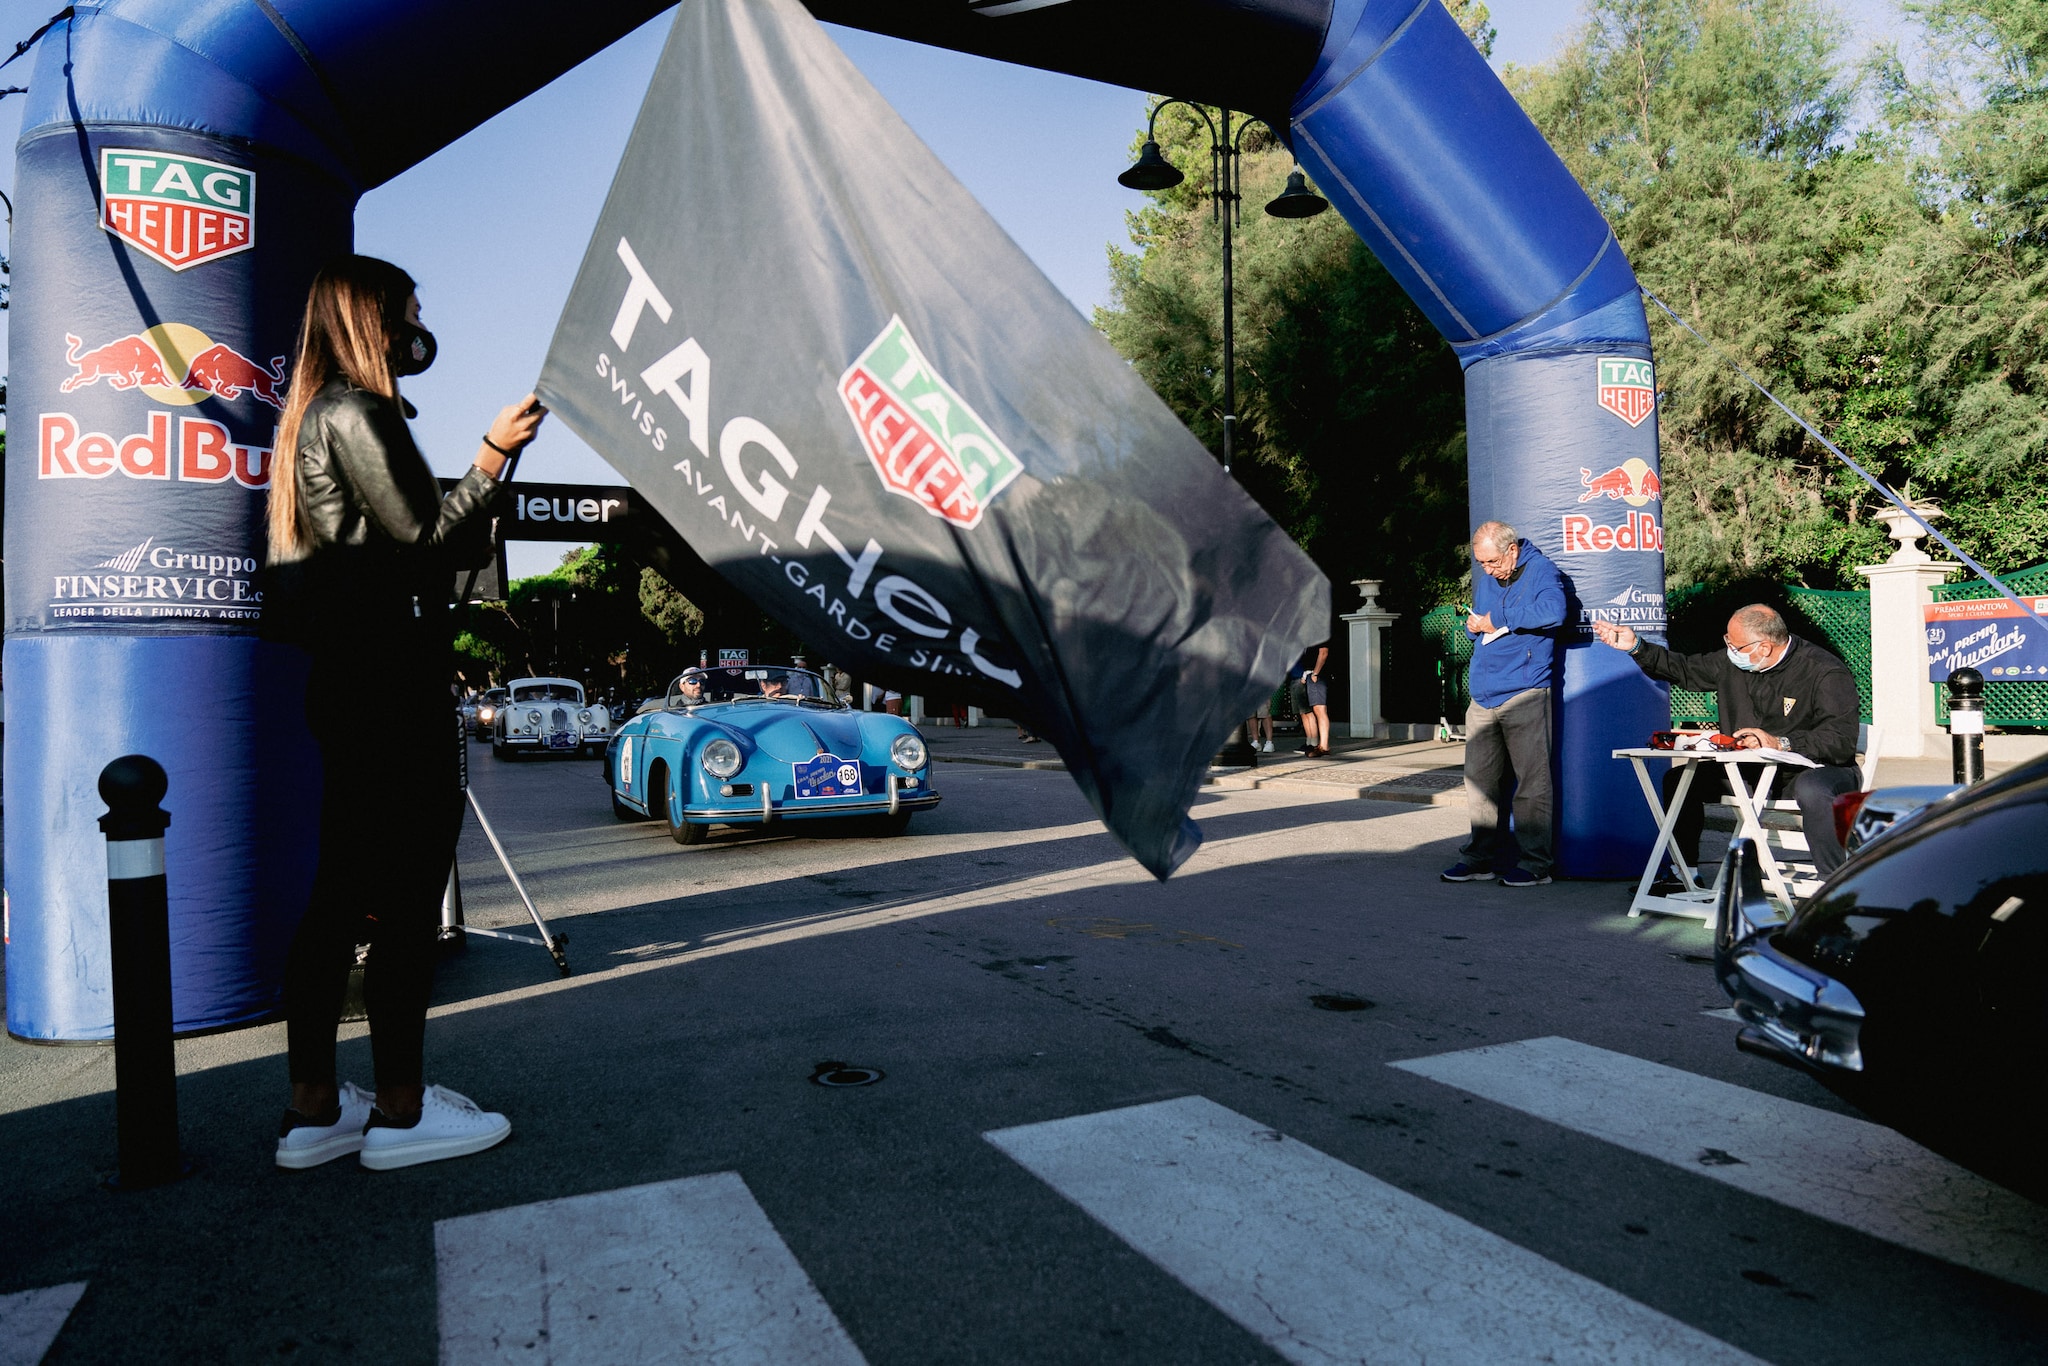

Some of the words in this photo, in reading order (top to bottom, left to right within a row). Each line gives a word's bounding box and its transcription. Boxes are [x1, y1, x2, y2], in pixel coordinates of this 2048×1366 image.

[114, 158, 241, 207] TAG
[111, 203, 244, 260] HEUER
[1605, 362, 1651, 386] TAG
[889, 335, 1000, 495] TAG
[1603, 388, 1654, 420] HEUER
[39, 411, 171, 480] Red
[179, 416, 275, 490] Bu
[610, 236, 1022, 689] TAGHeu
[847, 378, 977, 518] HEUER
[596, 353, 667, 451] SWISS
[674, 459, 897, 653] AVANT-GARDE
[1562, 511, 1637, 553] Red
[1639, 511, 1663, 552] Bu
[150, 547, 256, 577] Gruppo
[54, 576, 263, 602] FINSERVICE.c
[1934, 605, 1965, 613] PREMIO
[1967, 603, 2008, 611] MANTOVA
[54, 607, 95, 618] LEADER
[103, 607, 142, 617] DELLA
[152, 607, 210, 618] FINANZA
[219, 610, 261, 619] AGEVO
[722, 651, 746, 659] TAG
[1929, 647, 1949, 665] RAN
[1954, 623, 1997, 651] PREMIO
[839, 768, 856, 781] 168
